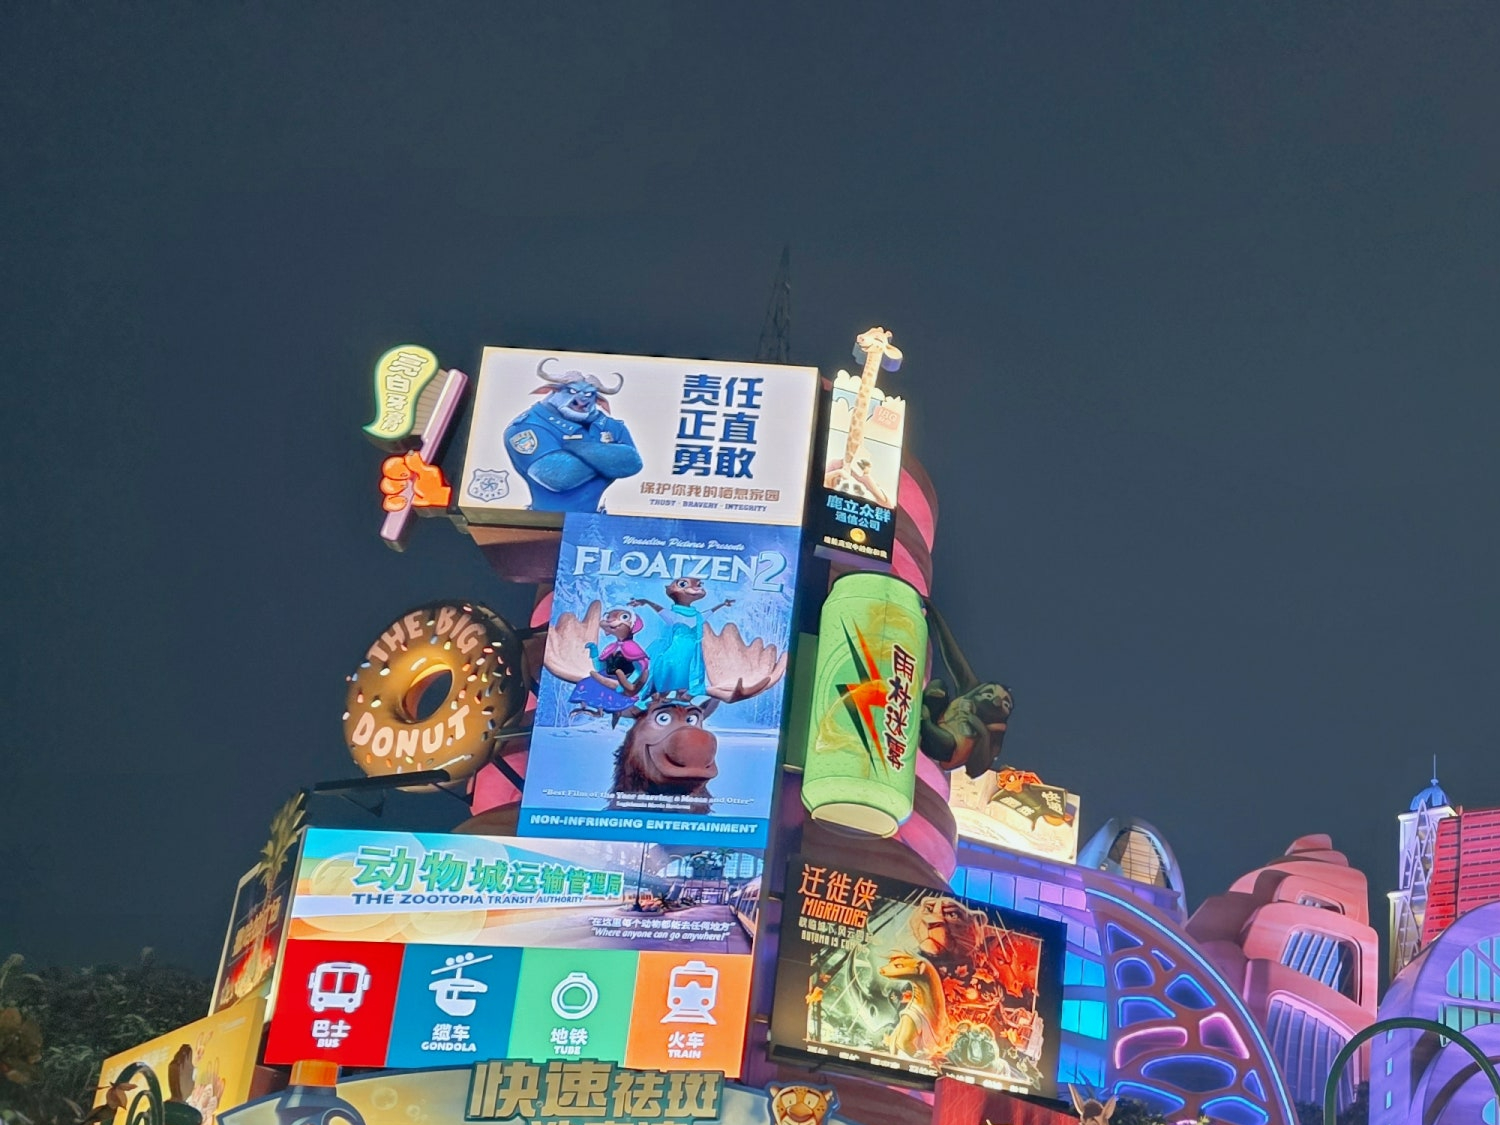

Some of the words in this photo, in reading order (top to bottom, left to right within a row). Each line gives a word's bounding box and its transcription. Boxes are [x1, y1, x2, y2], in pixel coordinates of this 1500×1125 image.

[681, 374, 764, 409] 责任
[676, 408, 759, 445] 正直
[671, 443, 756, 479] 勇敢
[640, 481, 781, 501] 保护你我的栖息家园
[650, 499, 677, 508] TRUST
[725, 503, 768, 513] INTEGRITY
[835, 511, 881, 532] 通信公司
[668, 538, 705, 549] Pictures
[707, 540, 745, 551] Presents
[572, 546, 757, 583] FLOATZEN
[752, 551, 788, 593] 2
[366, 610, 424, 662] THE
[435, 606, 487, 655] BIG
[352, 705, 470, 758] DONUT
[567, 789, 588, 797] Film
[599, 790, 616, 799] the
[616, 791, 636, 800] Year
[637, 792, 673, 803] starring
[709, 796, 724, 804] and
[530, 814, 643, 829] NON-INFRINGING
[646, 820, 758, 834] ENTERTAINMENT
[353, 845, 625, 897] 动物城运输管理局
[798, 863, 878, 911] 迁徙侠
[352, 893, 394, 905] THE
[400, 893, 484, 905] ZOOTOPIA
[487, 895, 533, 904] TRANSIT
[536, 895, 584, 904] AUTHORITY
[801, 897, 869, 928] MIGRATORS
[622, 930, 651, 939] anyone
[653, 931, 669, 939] can
[669, 932, 680, 941] go
[311, 1020, 351, 1039] 巴士
[432, 1023, 470, 1042] 缆车
[550, 1028, 588, 1046] 地铁
[317, 1038, 340, 1048] BUS
[421, 1041, 477, 1052] GONDOLA
[668, 1031, 705, 1049] 火车
[554, 1045, 581, 1055] TUBE
[668, 1048, 701, 1059] TRAIN
[468, 1061, 721, 1118] 快速祛斑
